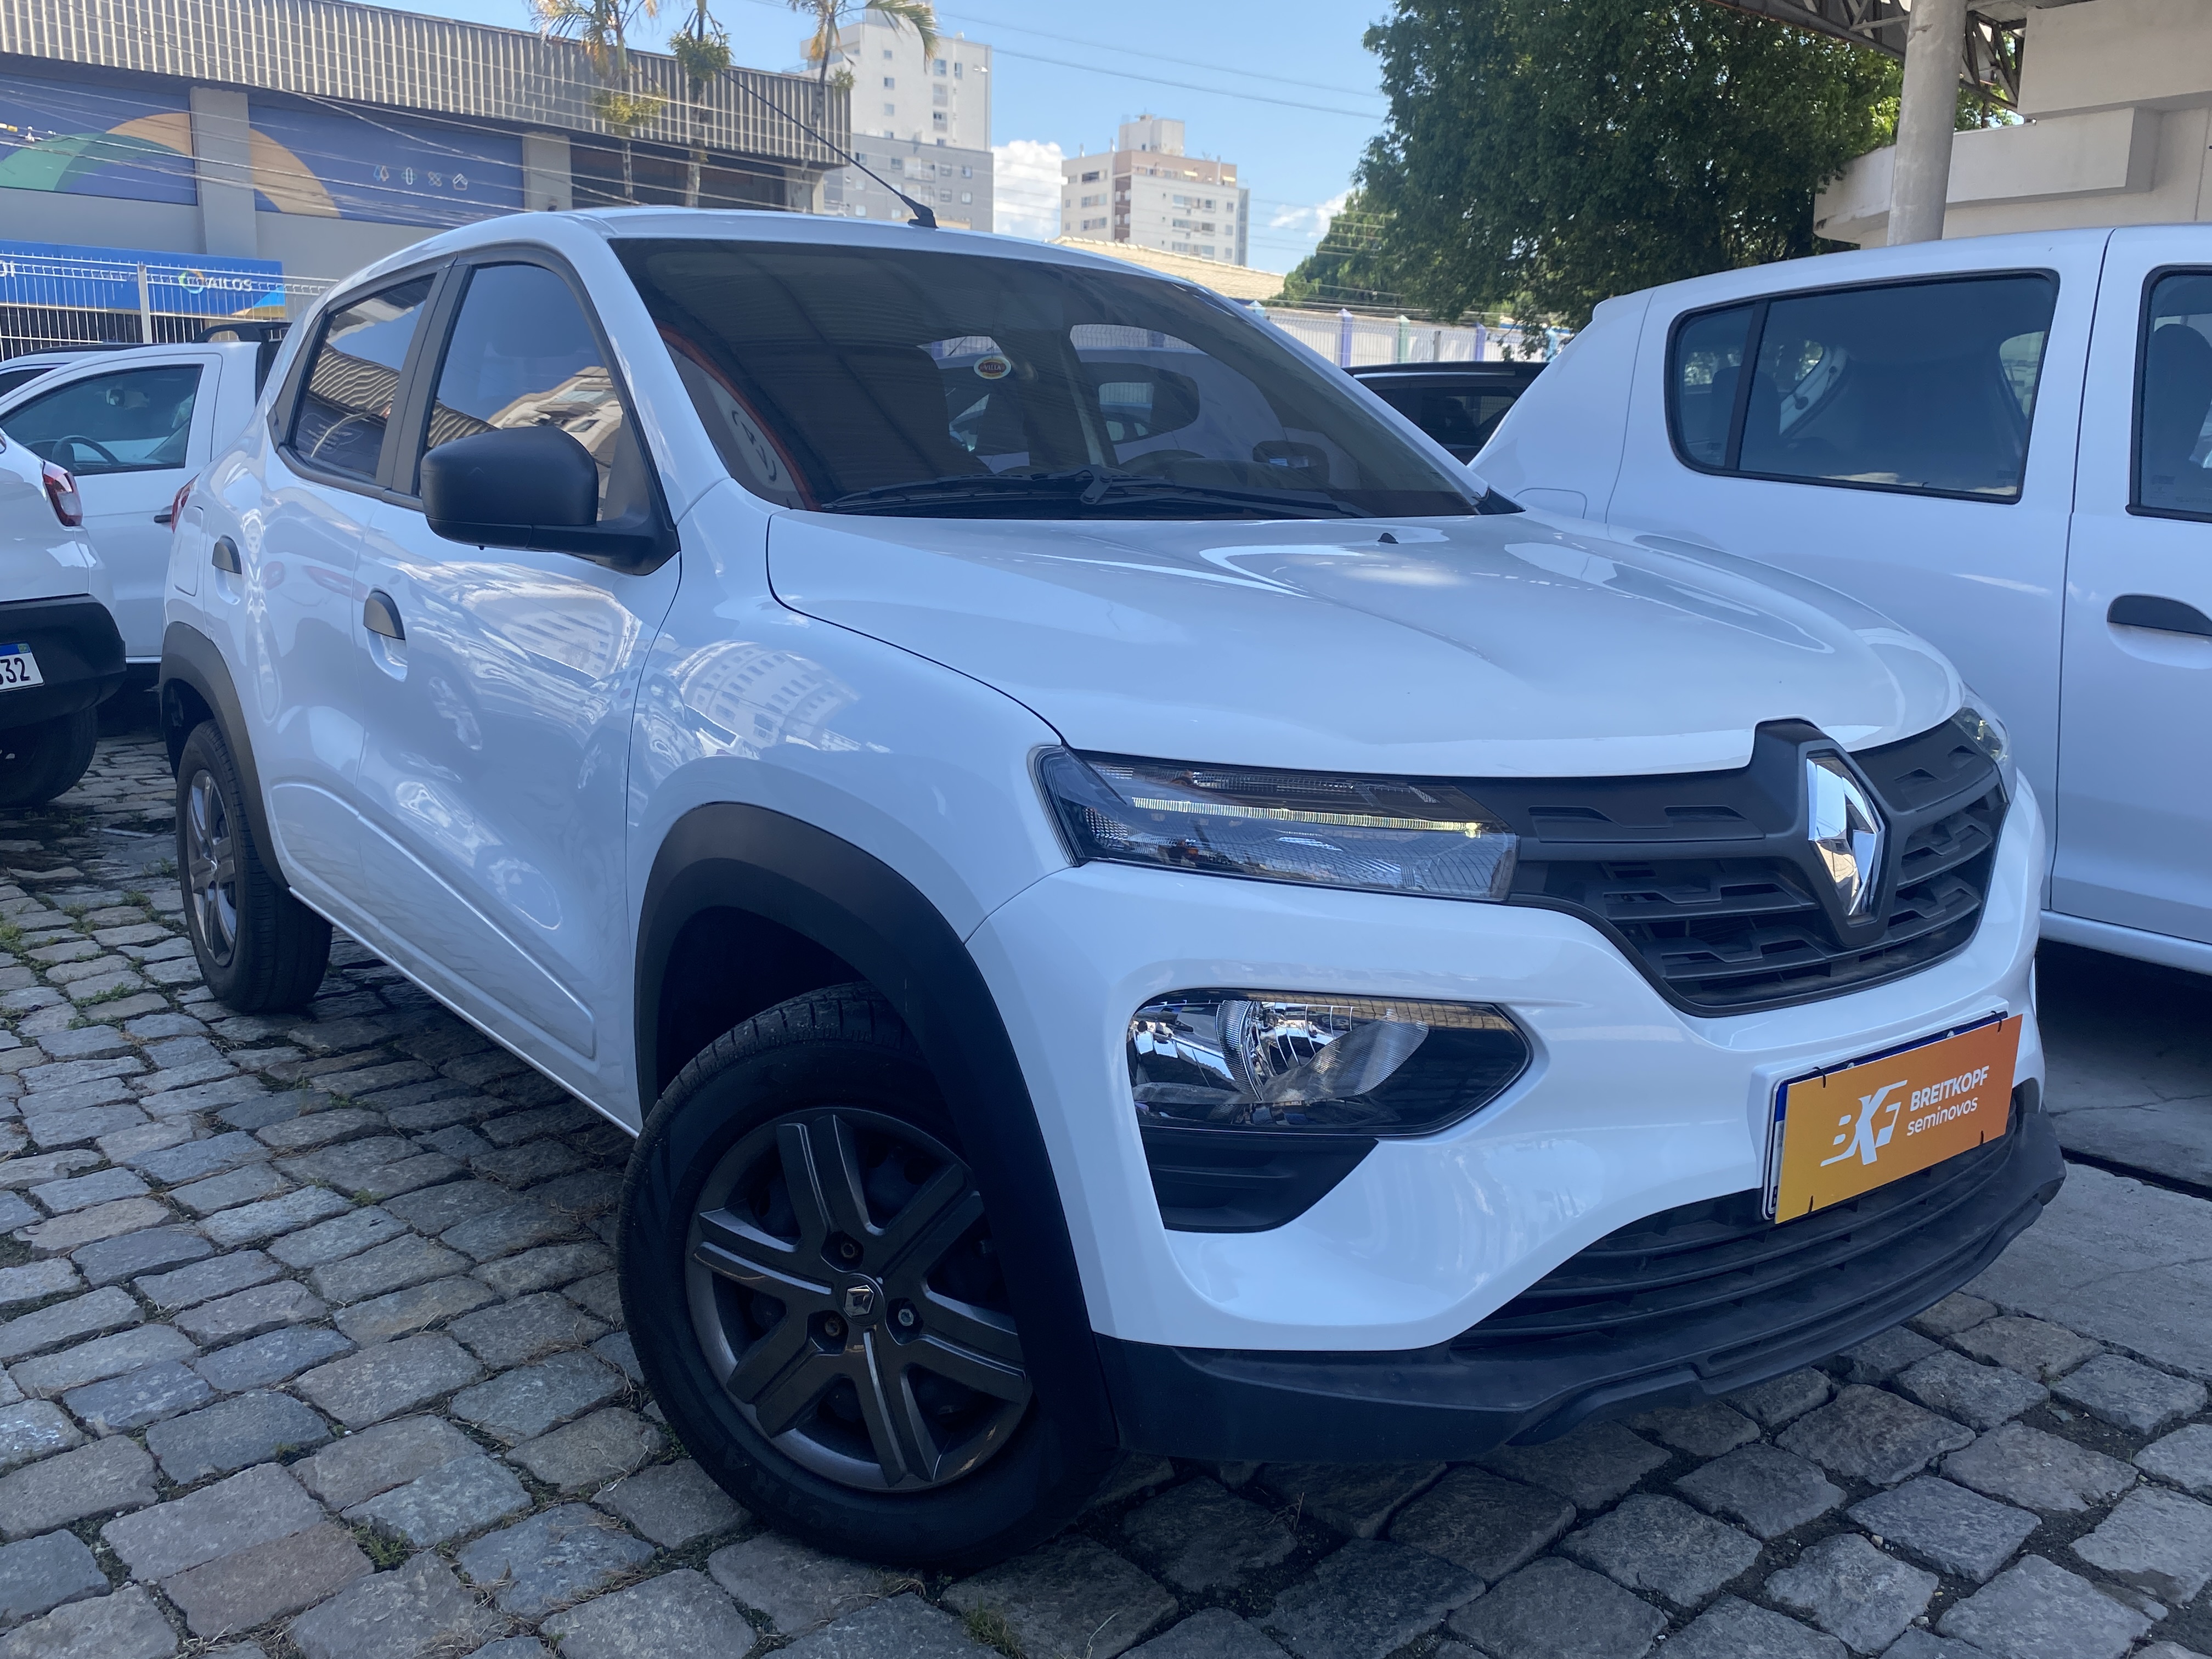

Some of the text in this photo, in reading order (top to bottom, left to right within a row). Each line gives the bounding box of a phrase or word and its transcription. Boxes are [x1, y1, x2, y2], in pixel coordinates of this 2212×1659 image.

[0, 657, 30, 685] 32
[1910, 1065, 1990, 1112] BREITKOPF
[1906, 1097, 1978, 1136] seminovos
